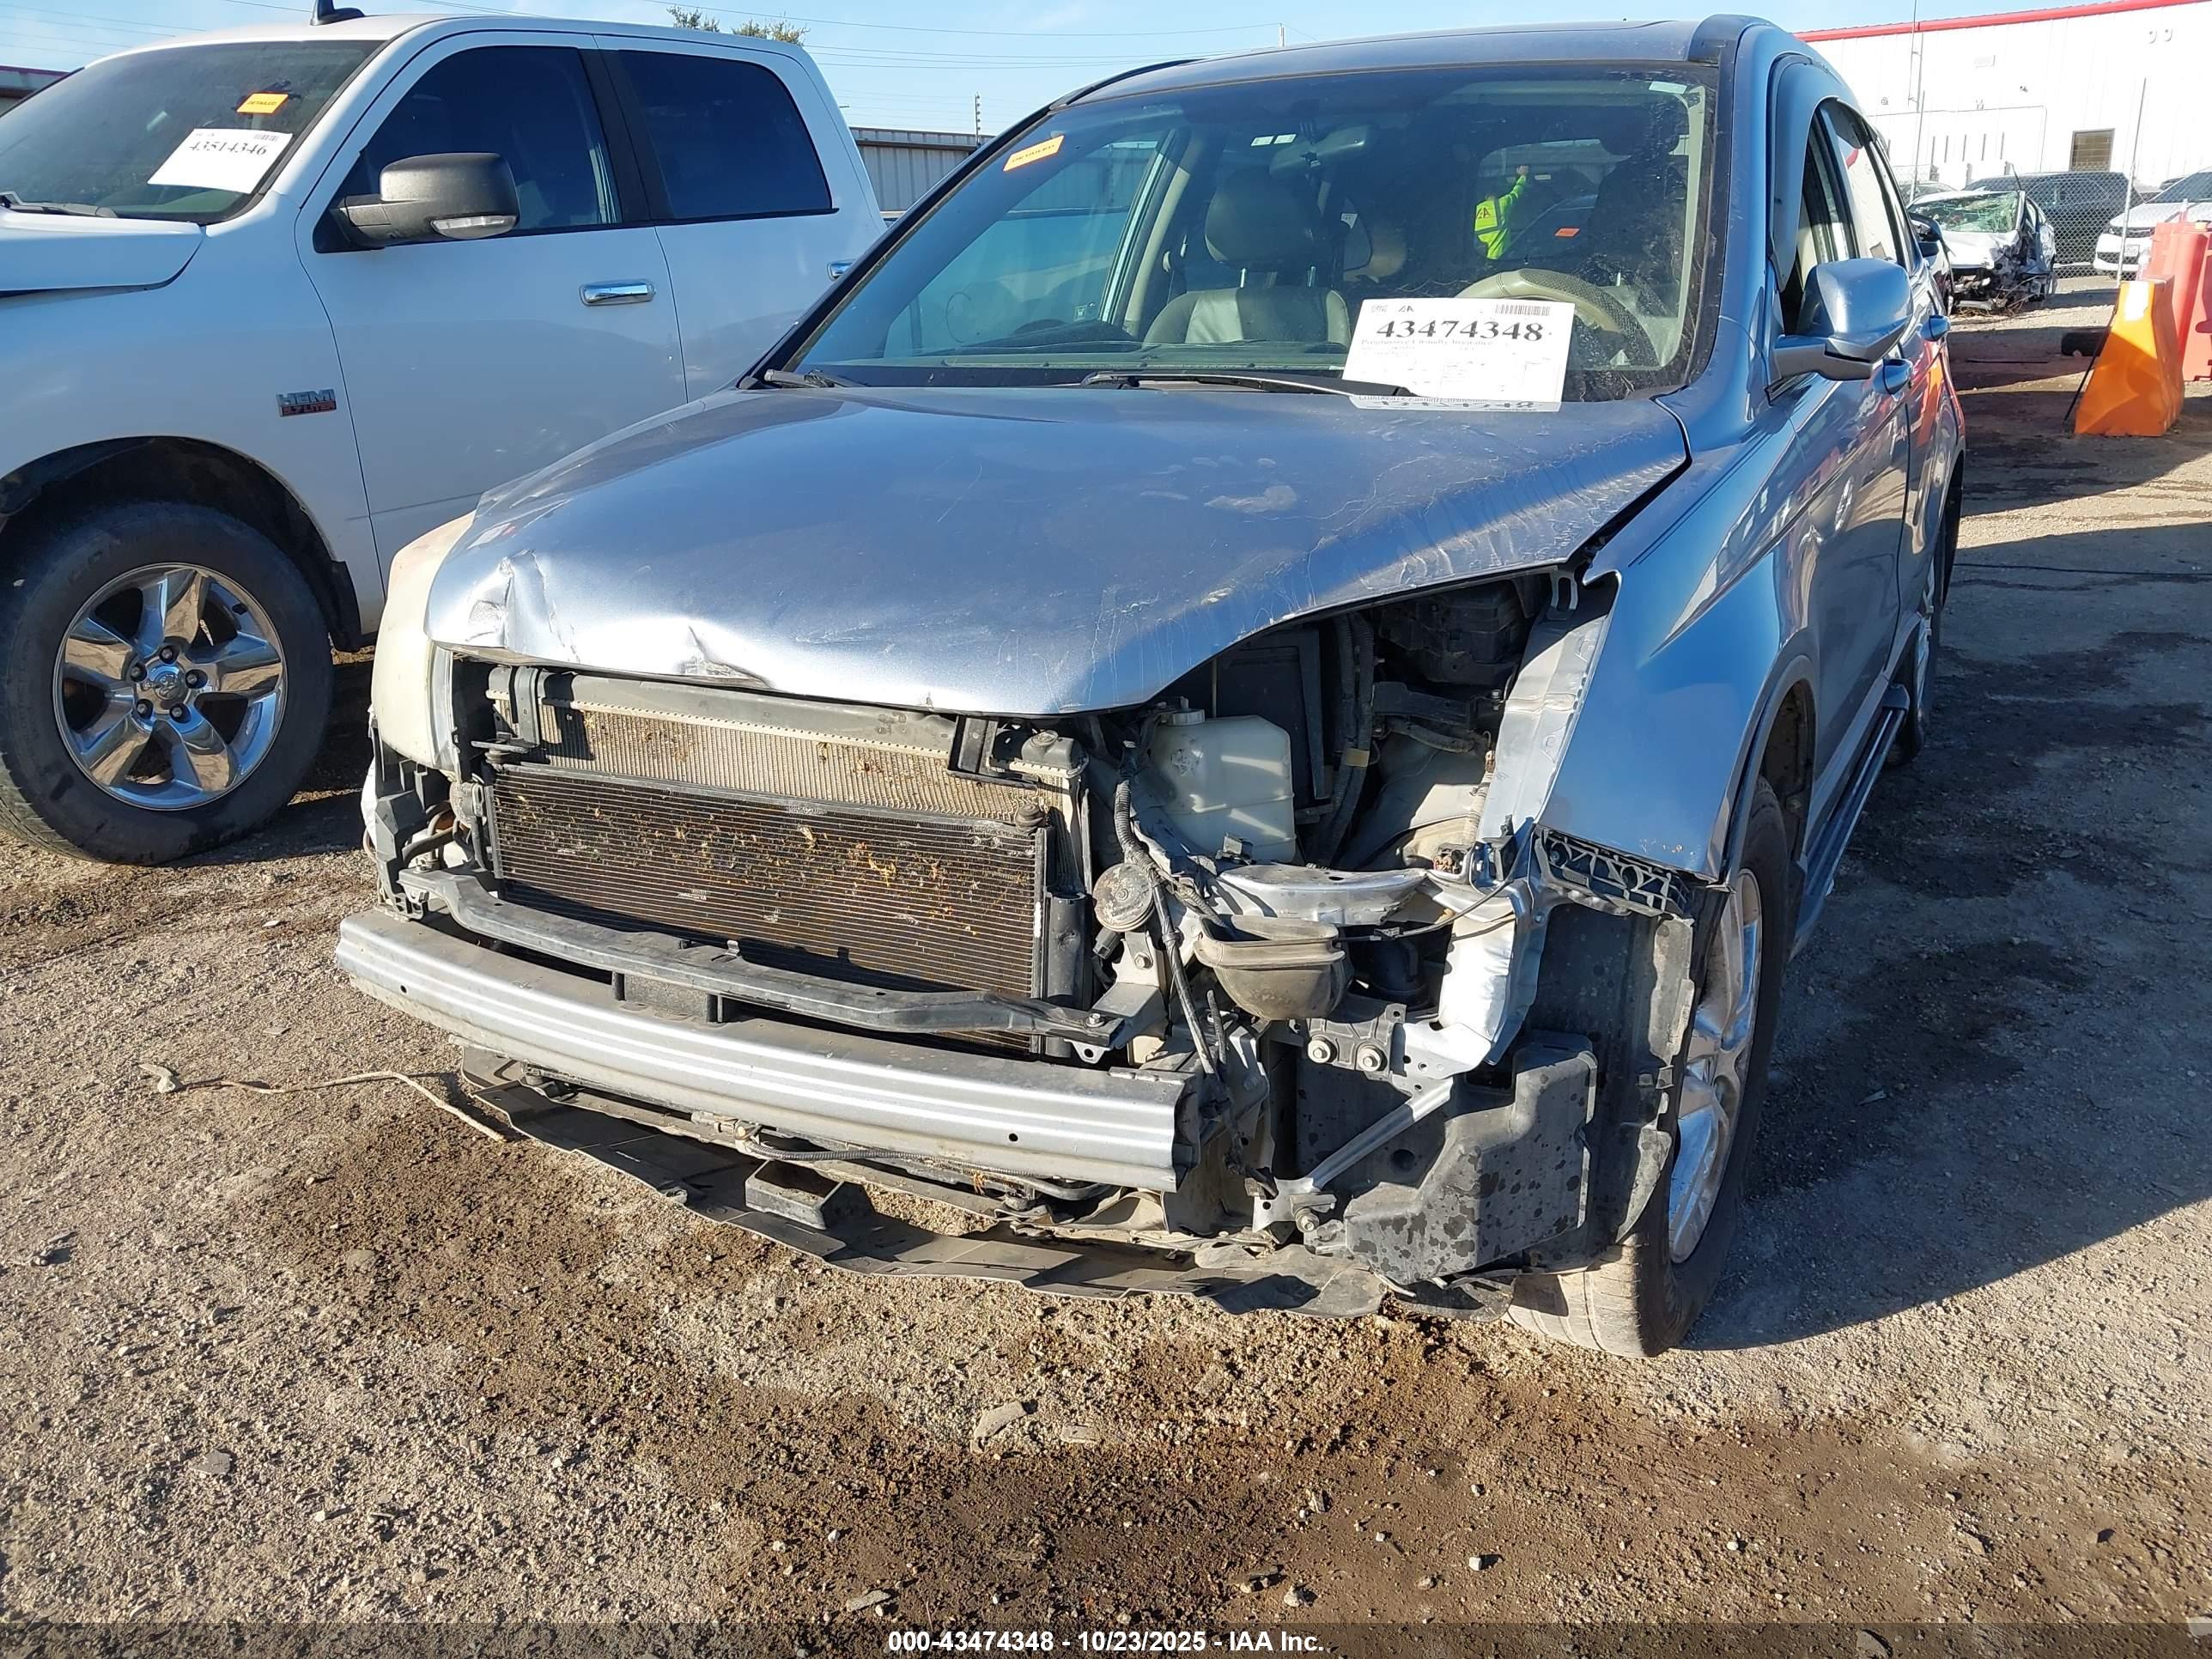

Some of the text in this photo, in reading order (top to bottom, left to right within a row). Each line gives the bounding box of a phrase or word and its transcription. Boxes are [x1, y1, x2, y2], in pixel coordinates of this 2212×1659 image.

[188, 141, 269, 155] 43514346
[1376, 319, 1544, 342] 43474348
[276, 389, 336, 406] HEMI
